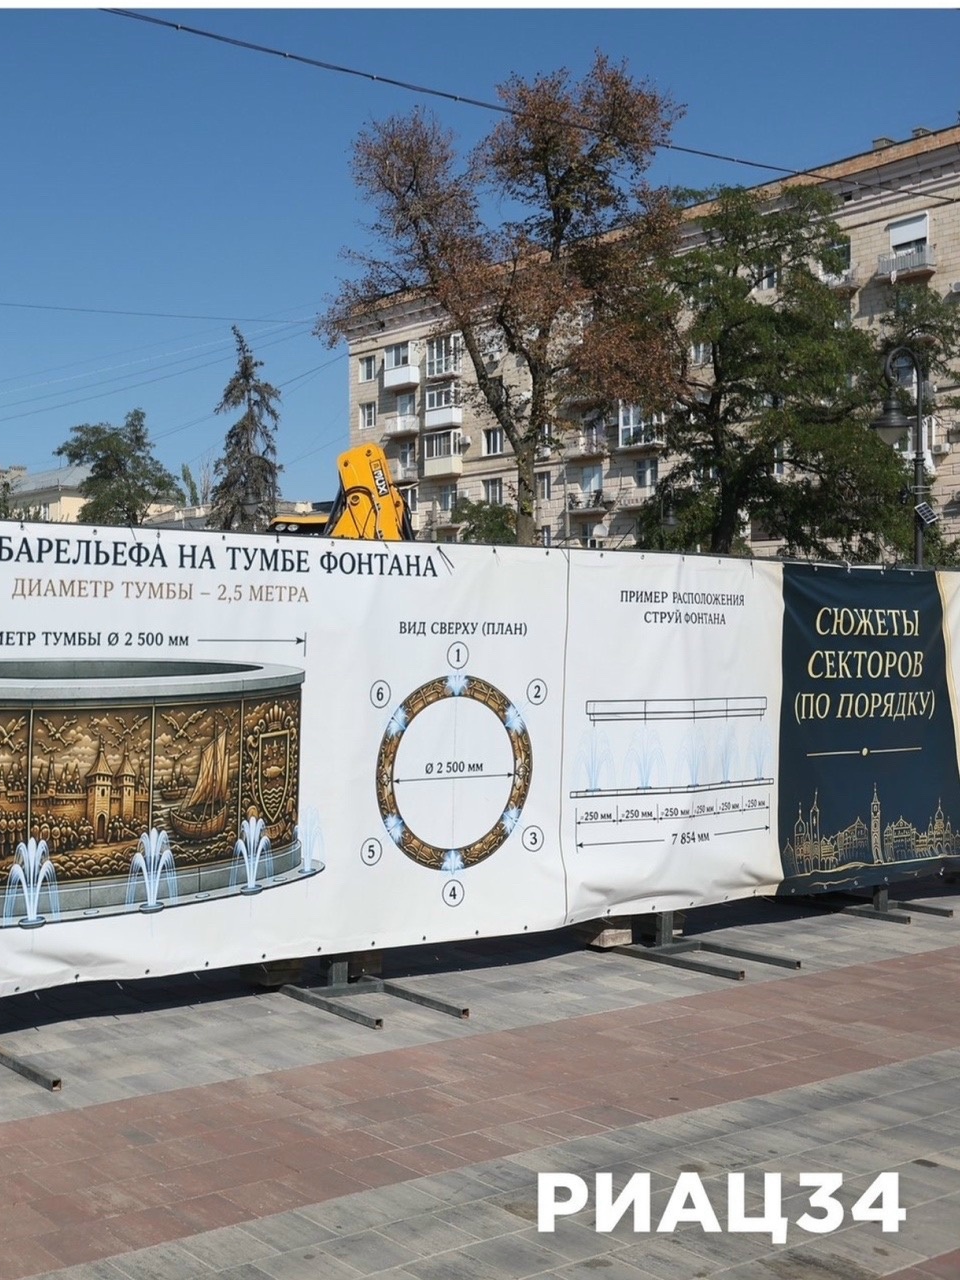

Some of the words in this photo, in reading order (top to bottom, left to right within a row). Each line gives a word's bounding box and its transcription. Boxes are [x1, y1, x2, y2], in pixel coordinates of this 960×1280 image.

[179, 545, 215, 569] НА
[226, 547, 309, 572] ТУМБЕ
[320, 552, 437, 577] ФОНТАНА
[12, 578, 114, 599] ДИАМЕТР
[122, 582, 193, 600] ТУМБЫ
[218, 584, 242, 603] 2,5
[249, 585, 308, 602] МЕТРА
[621, 591, 668, 603] ПРИМЕР
[673, 592, 744, 606] РАСПОЛОЖЕНИЯ
[644, 610, 682, 623] СТРУЙ
[684, 612, 726, 625] ФОНТАНА
[816, 607, 918, 636] СЮЖЕТЫ
[399, 622, 426, 636] ВИД
[431, 622, 478, 634] СВЕРХУ
[482, 622, 527, 636] (ПЛАН)
[42, 632, 101, 646] ТУМБЫ
[125, 632, 132, 646] 2
[138, 632, 163, 646] 500
[169, 636, 188, 646] мм
[456, 649, 460, 662] 1
[808, 651, 923, 678] СЕКТОРОВ
[377, 687, 383, 701] 6
[534, 685, 540, 698] 2
[795, 692, 830, 724] (ПО
[836, 690, 934, 721] ПОРЯДКУ)
[437, 762, 443, 773] 2
[446, 761, 465, 773] 500
[468, 763, 483, 772] мм
[680, 808, 690, 816] мм
[706, 805, 715, 813] мм
[732, 802, 740, 810] мм
[758, 799, 766, 807] мм
[530, 832, 537, 845] 3
[672, 833, 678, 845] 7
[681, 832, 695, 844] 854
[698, 833, 709, 842] мм
[368, 845, 375, 859] 5
[449, 886, 456, 899] 4
